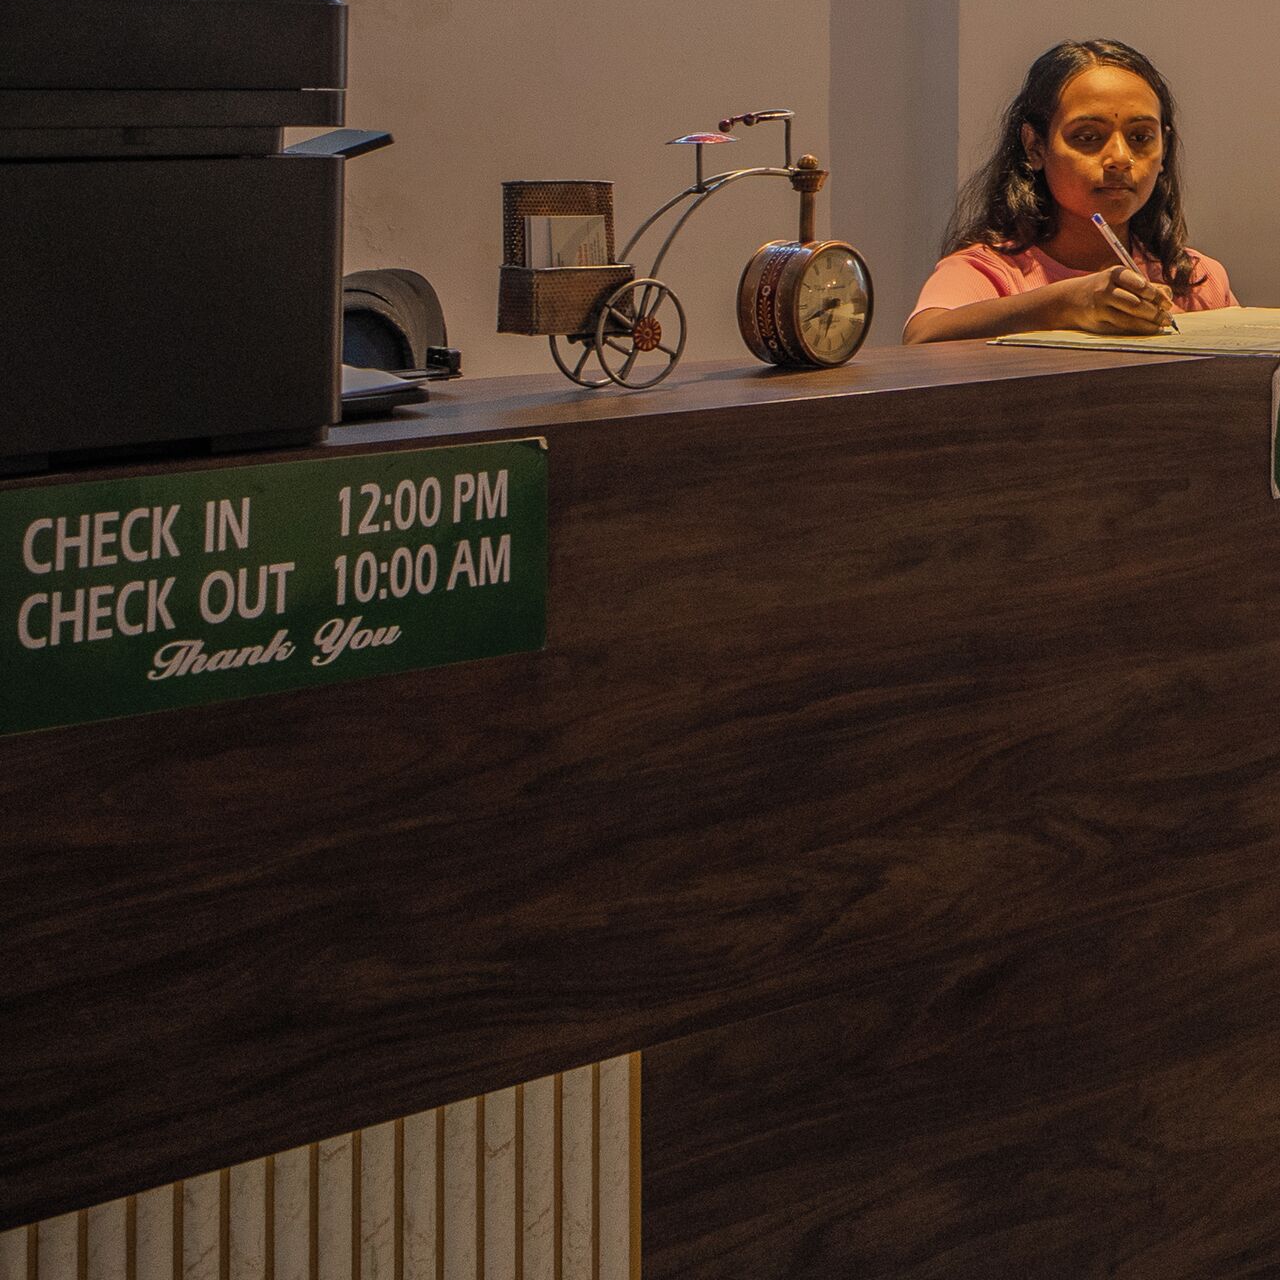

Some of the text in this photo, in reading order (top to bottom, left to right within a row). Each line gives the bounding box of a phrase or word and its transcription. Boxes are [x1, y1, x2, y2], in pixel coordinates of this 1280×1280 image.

[23, 470, 509, 575] CHECK IN 12:00 PM
[17, 534, 511, 650] CHECK OUT 10:00 AM
[147, 616, 402, 681] Thank You
